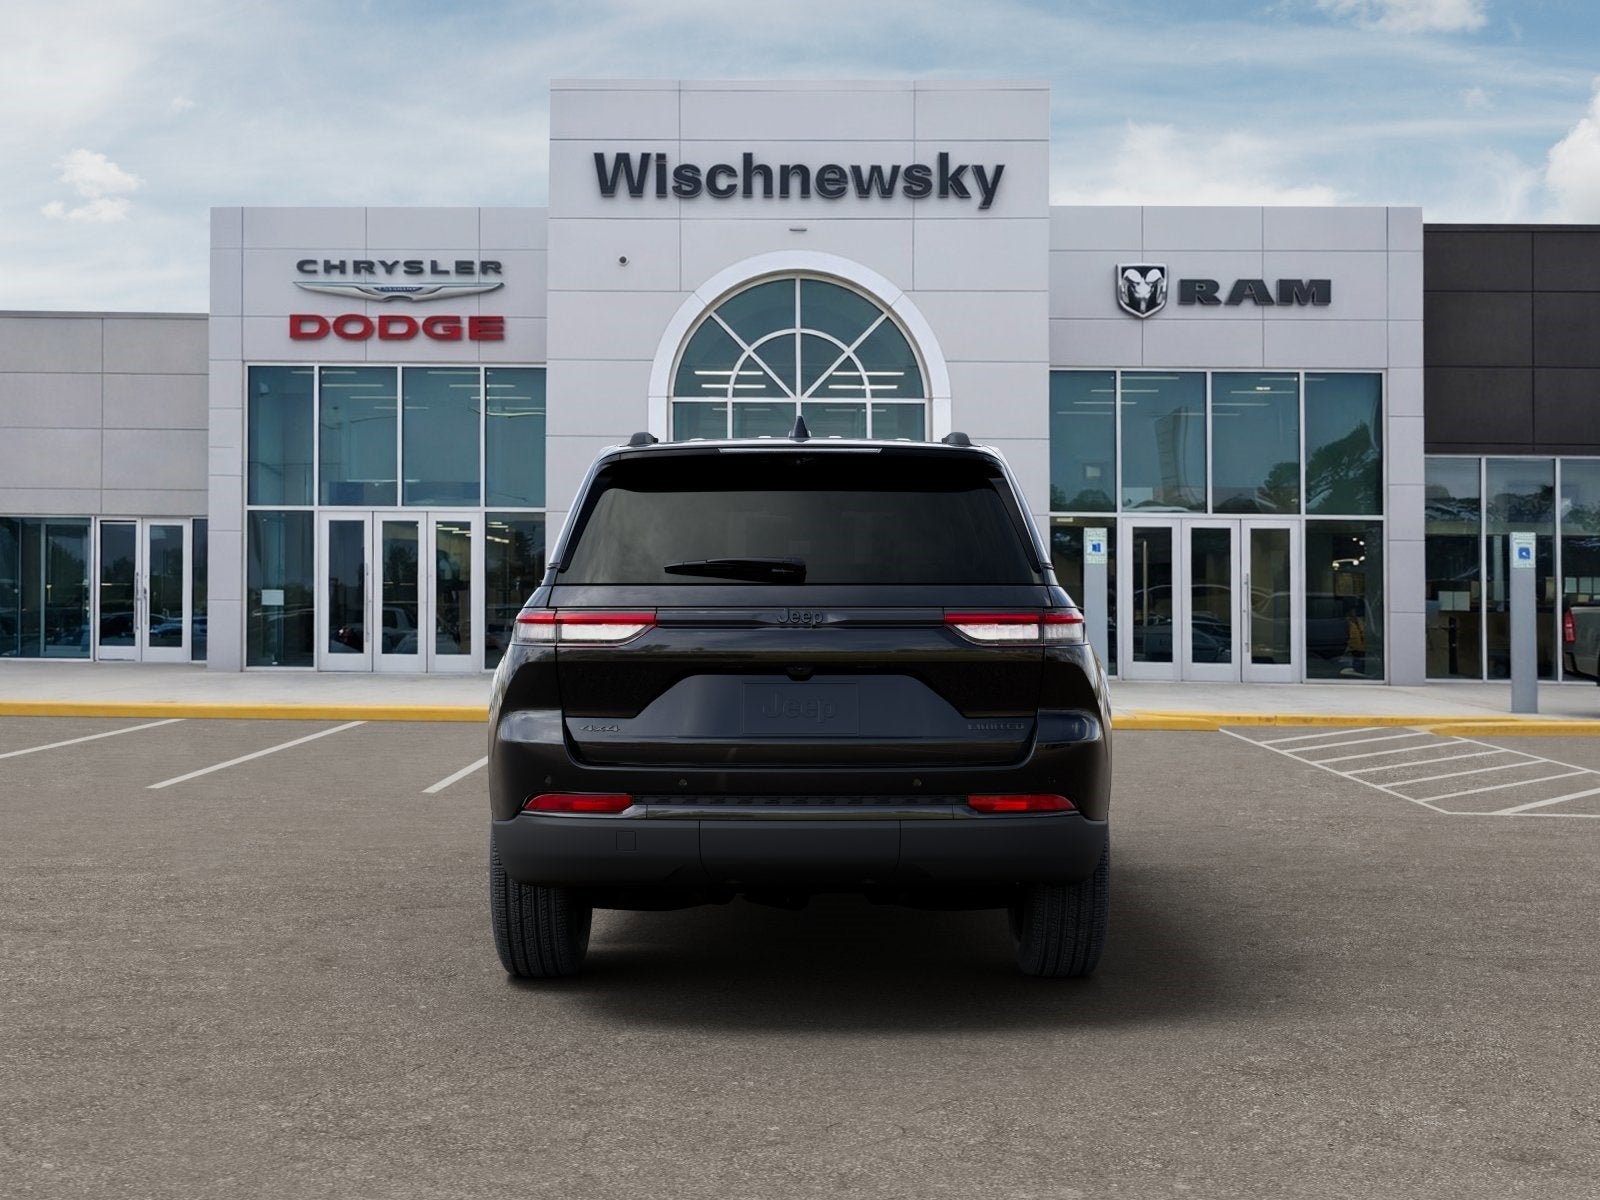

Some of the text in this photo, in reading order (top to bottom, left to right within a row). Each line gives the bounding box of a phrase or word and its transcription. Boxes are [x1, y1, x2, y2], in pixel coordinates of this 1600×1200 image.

[594, 152, 1005, 210] Wischnewsky
[296, 259, 503, 275] CHRYSLER
[1178, 279, 1331, 306] RAM
[289, 314, 505, 341] DODGE
[777, 607, 823, 627] Jeep
[762, 691, 837, 723] Jeep
